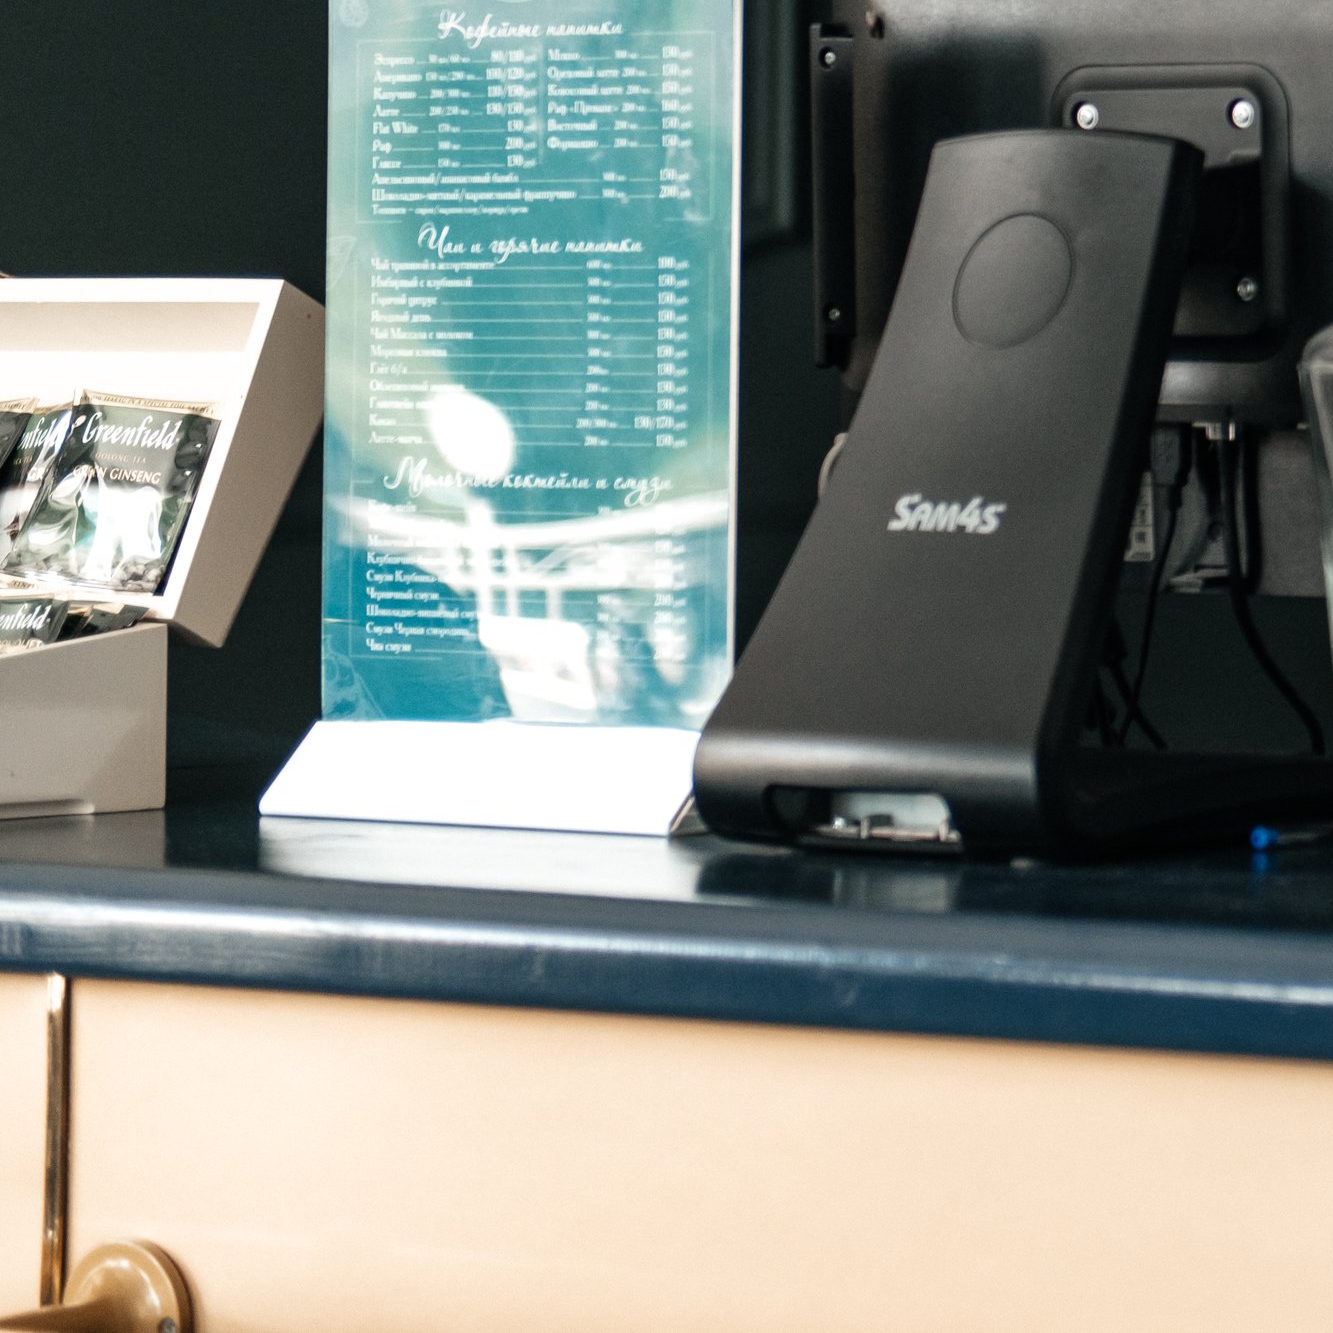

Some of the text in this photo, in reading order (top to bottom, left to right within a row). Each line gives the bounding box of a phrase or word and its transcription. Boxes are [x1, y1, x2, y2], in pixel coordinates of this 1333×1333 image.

[437, 9, 625, 50] Кофейные напитки
[488, 236, 562, 264] горячие
[565, 238, 644, 254] напитки
[82, 412, 183, 451] Greenfield
[109, 468, 162, 484] GINSENG
[502, 471, 593, 490] коктейли
[595, 477, 608, 490] и
[613, 474, 674, 507] смузи
